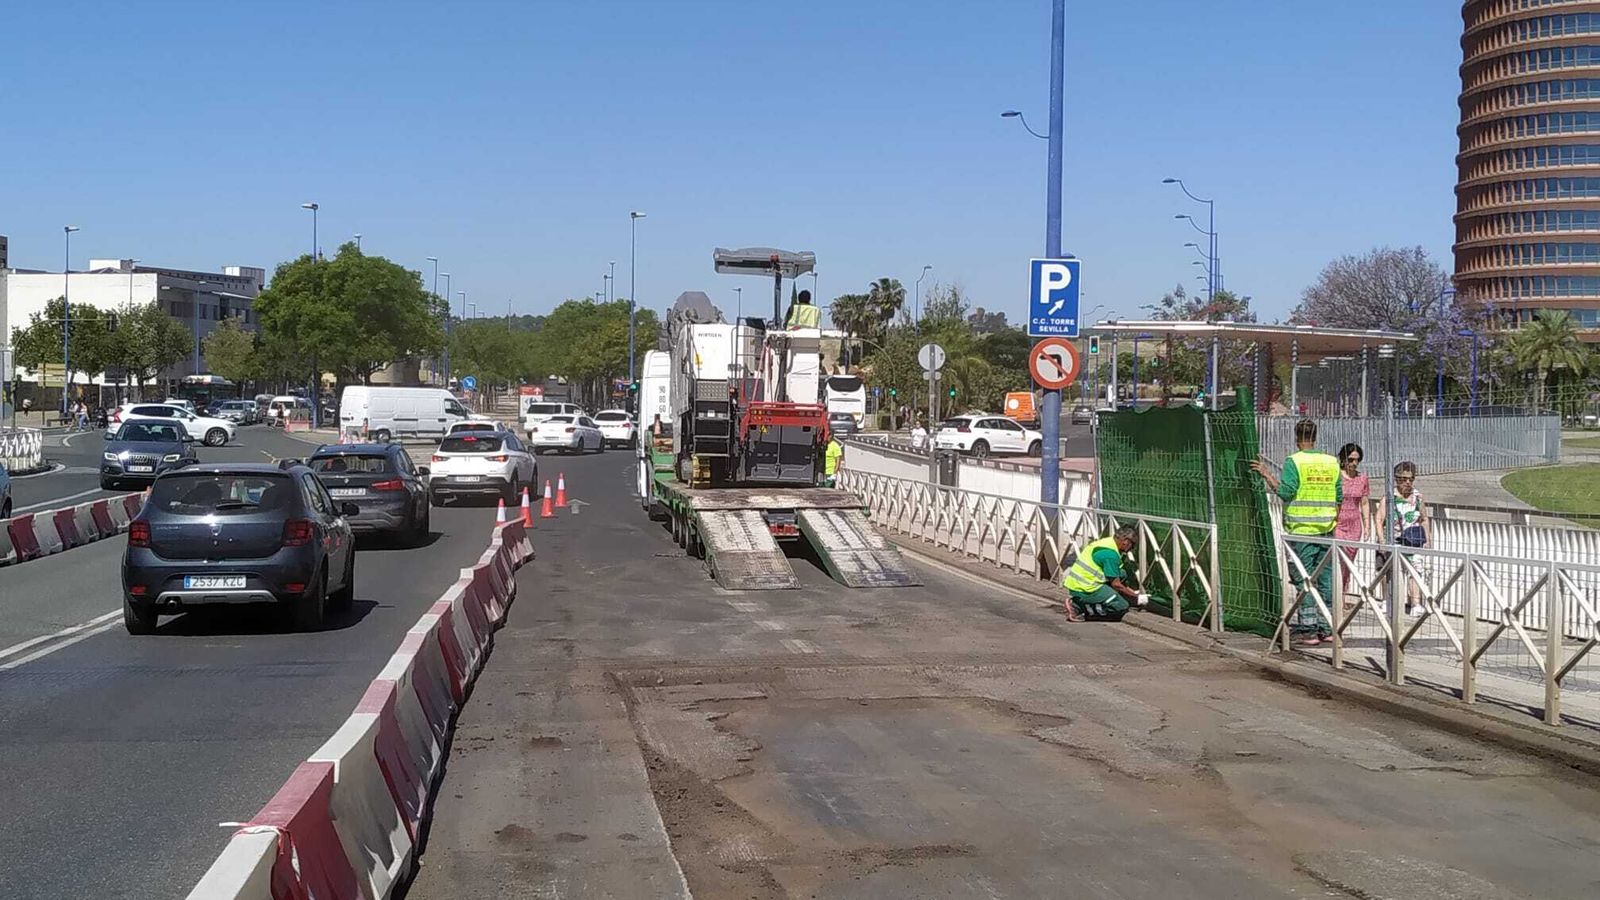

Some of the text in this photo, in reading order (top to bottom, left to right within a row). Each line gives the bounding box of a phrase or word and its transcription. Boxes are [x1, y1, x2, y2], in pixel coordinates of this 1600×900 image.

[1040, 263, 1071, 304] P
[1050, 318, 1075, 326] TORRE
[1038, 325, 1069, 333] SEVILLA
[192, 576, 244, 587] 2537 KZC
